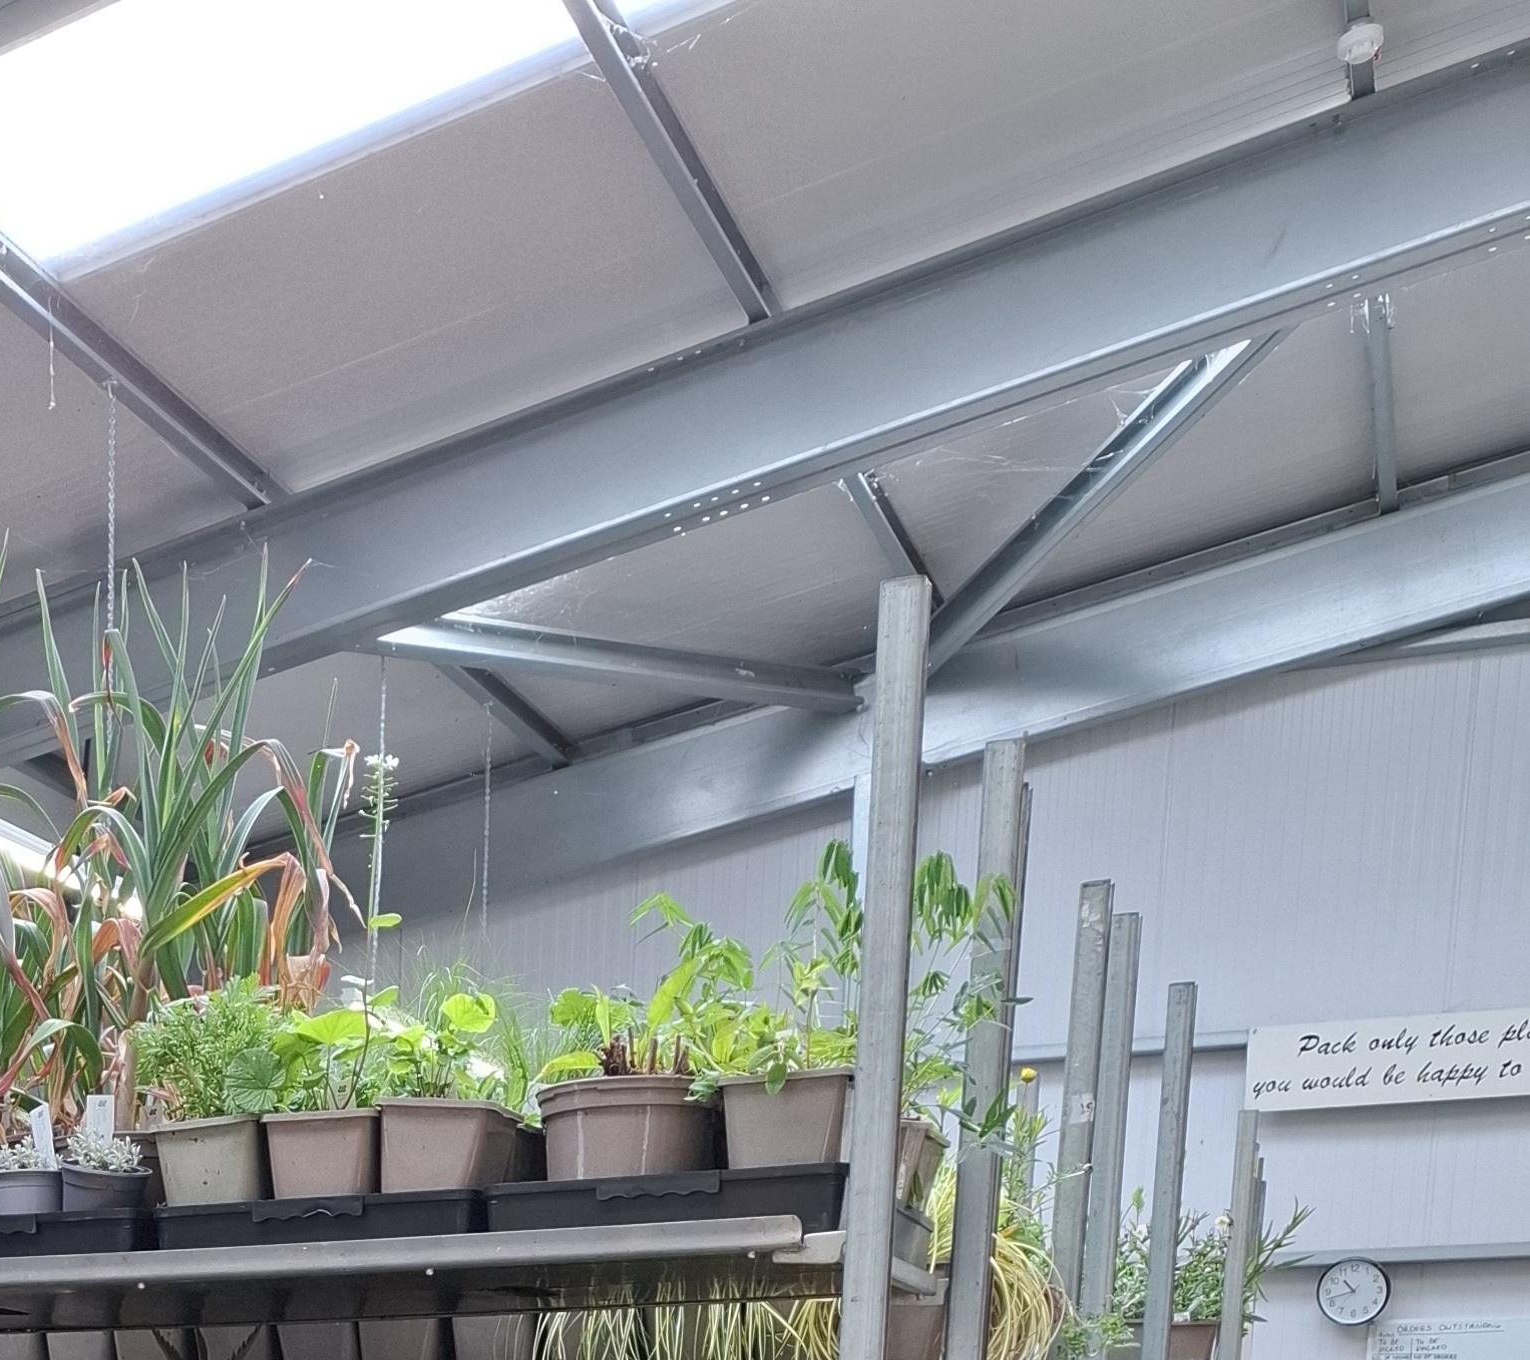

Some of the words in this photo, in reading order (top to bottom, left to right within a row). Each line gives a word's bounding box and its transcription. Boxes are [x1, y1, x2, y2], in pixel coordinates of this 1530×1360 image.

[1297, 1031, 1358, 1057] Pack
[1369, 1028, 1419, 1055] only
[1428, 1024, 1490, 1048] those
[1497, 1018, 1530, 1049] pl
[1252, 1078, 1292, 1100] you
[1301, 1067, 1372, 1091] would
[1383, 1063, 1406, 1086] be
[1416, 1061, 1489, 1087] happy
[1499, 1059, 1522, 1079] to
[1350, 1264, 1359, 1272] 12
[1365, 1267, 1369, 1275] 1
[1330, 1277, 1339, 1285] 10
[1372, 1274, 1379, 1283] 2
[1325, 1288, 1331, 1296] 9
[1376, 1286, 1383, 1294] 3
[1329, 1299, 1335, 1307] 8
[1338, 1307, 1344, 1315] 7
[1350, 1309, 1356, 1318] 6
[1363, 1306, 1369, 1314] 5
